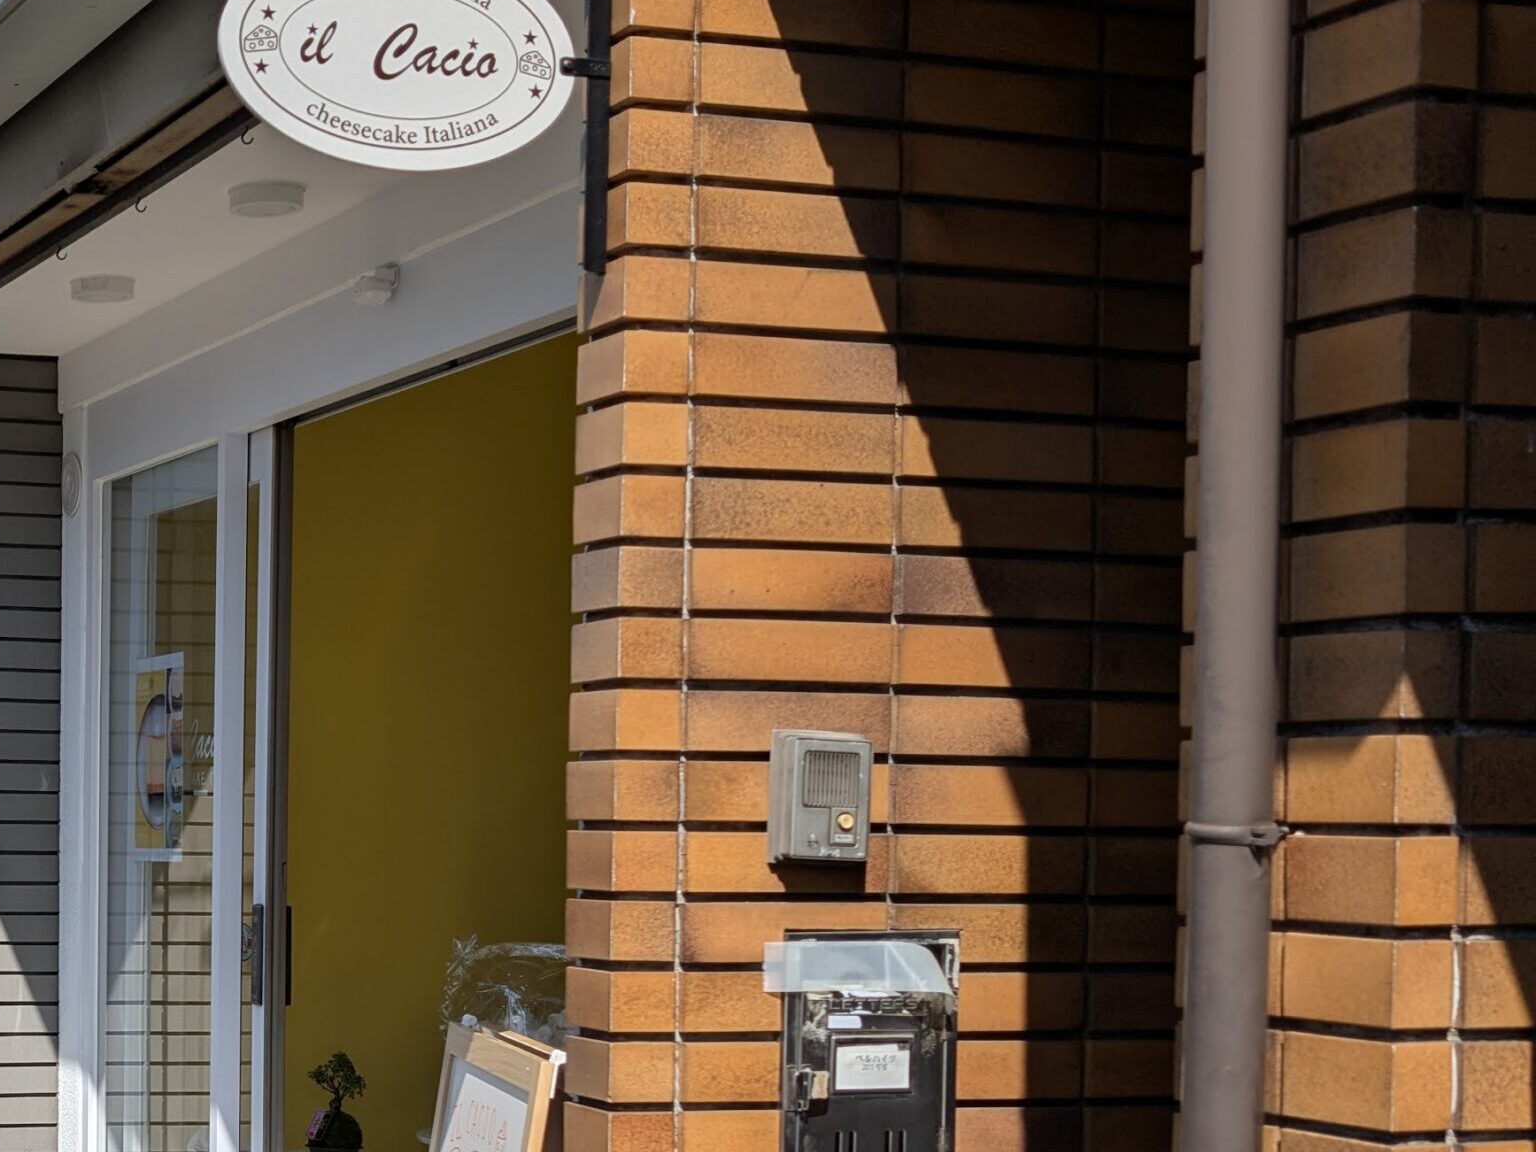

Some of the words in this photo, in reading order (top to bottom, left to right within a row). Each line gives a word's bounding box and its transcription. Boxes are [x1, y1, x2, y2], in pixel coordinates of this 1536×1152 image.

[300, 20, 338, 65] il
[373, 22, 498, 81] Cacio
[306, 101, 418, 145] cheesecake
[424, 110, 499, 144] Italiana
[828, 998, 918, 1010] LETTERS
